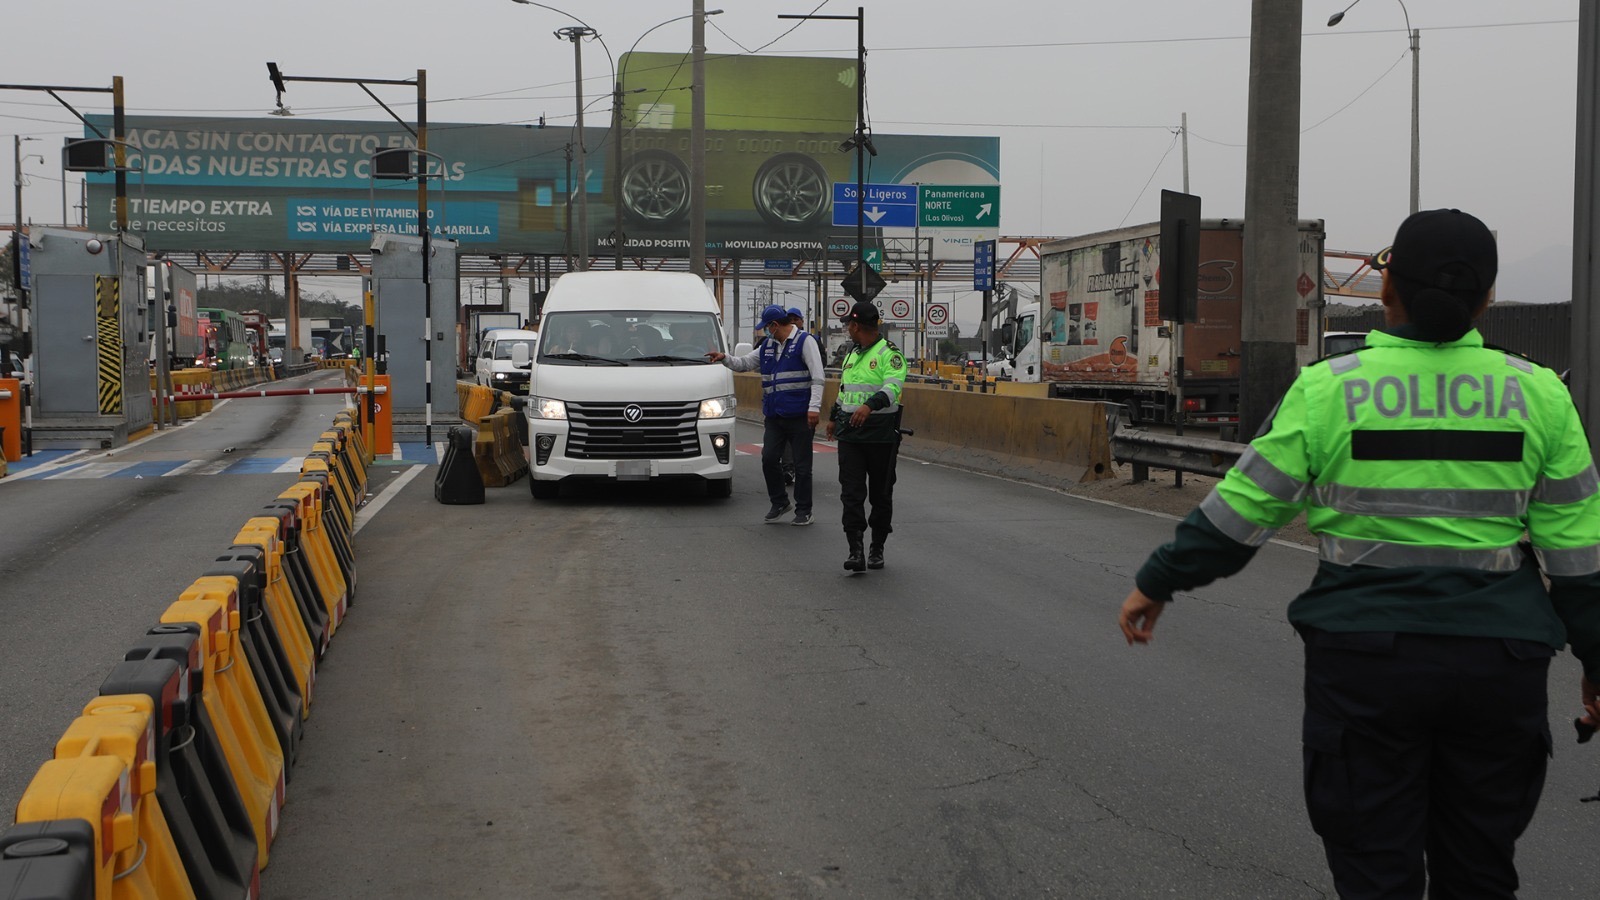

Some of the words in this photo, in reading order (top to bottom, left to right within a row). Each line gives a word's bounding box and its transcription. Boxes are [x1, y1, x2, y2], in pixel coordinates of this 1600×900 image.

[109, 128, 179, 149] AGA
[185, 129, 231, 150] SIN
[237, 131, 381, 154] CONTACTO
[208, 155, 347, 178] NUESTRAS
[354, 159, 466, 181] CETAS
[869, 188, 907, 202] Ligeros
[925, 189, 985, 198] Panamericana
[130, 198, 206, 214] TIEMPO
[210, 200, 272, 216] EXTRA
[925, 201, 952, 210] NORTE
[344, 207, 359, 217] DE
[361, 207, 434, 219] EVITAMIENO
[925, 214, 940, 222] (Los
[941, 214, 964, 222] Olivos)
[146, 217, 226, 232] necesitas
[345, 223, 396, 234] EXPRESA
[434, 225, 491, 235] AMARILLA
[654, 239, 691, 248] POSITIV
[725, 240, 779, 249] MOVILIDAD
[780, 241, 823, 250] POSITIVA
[931, 309, 944, 318] 20
[1343, 374, 1530, 423] POLICIA
